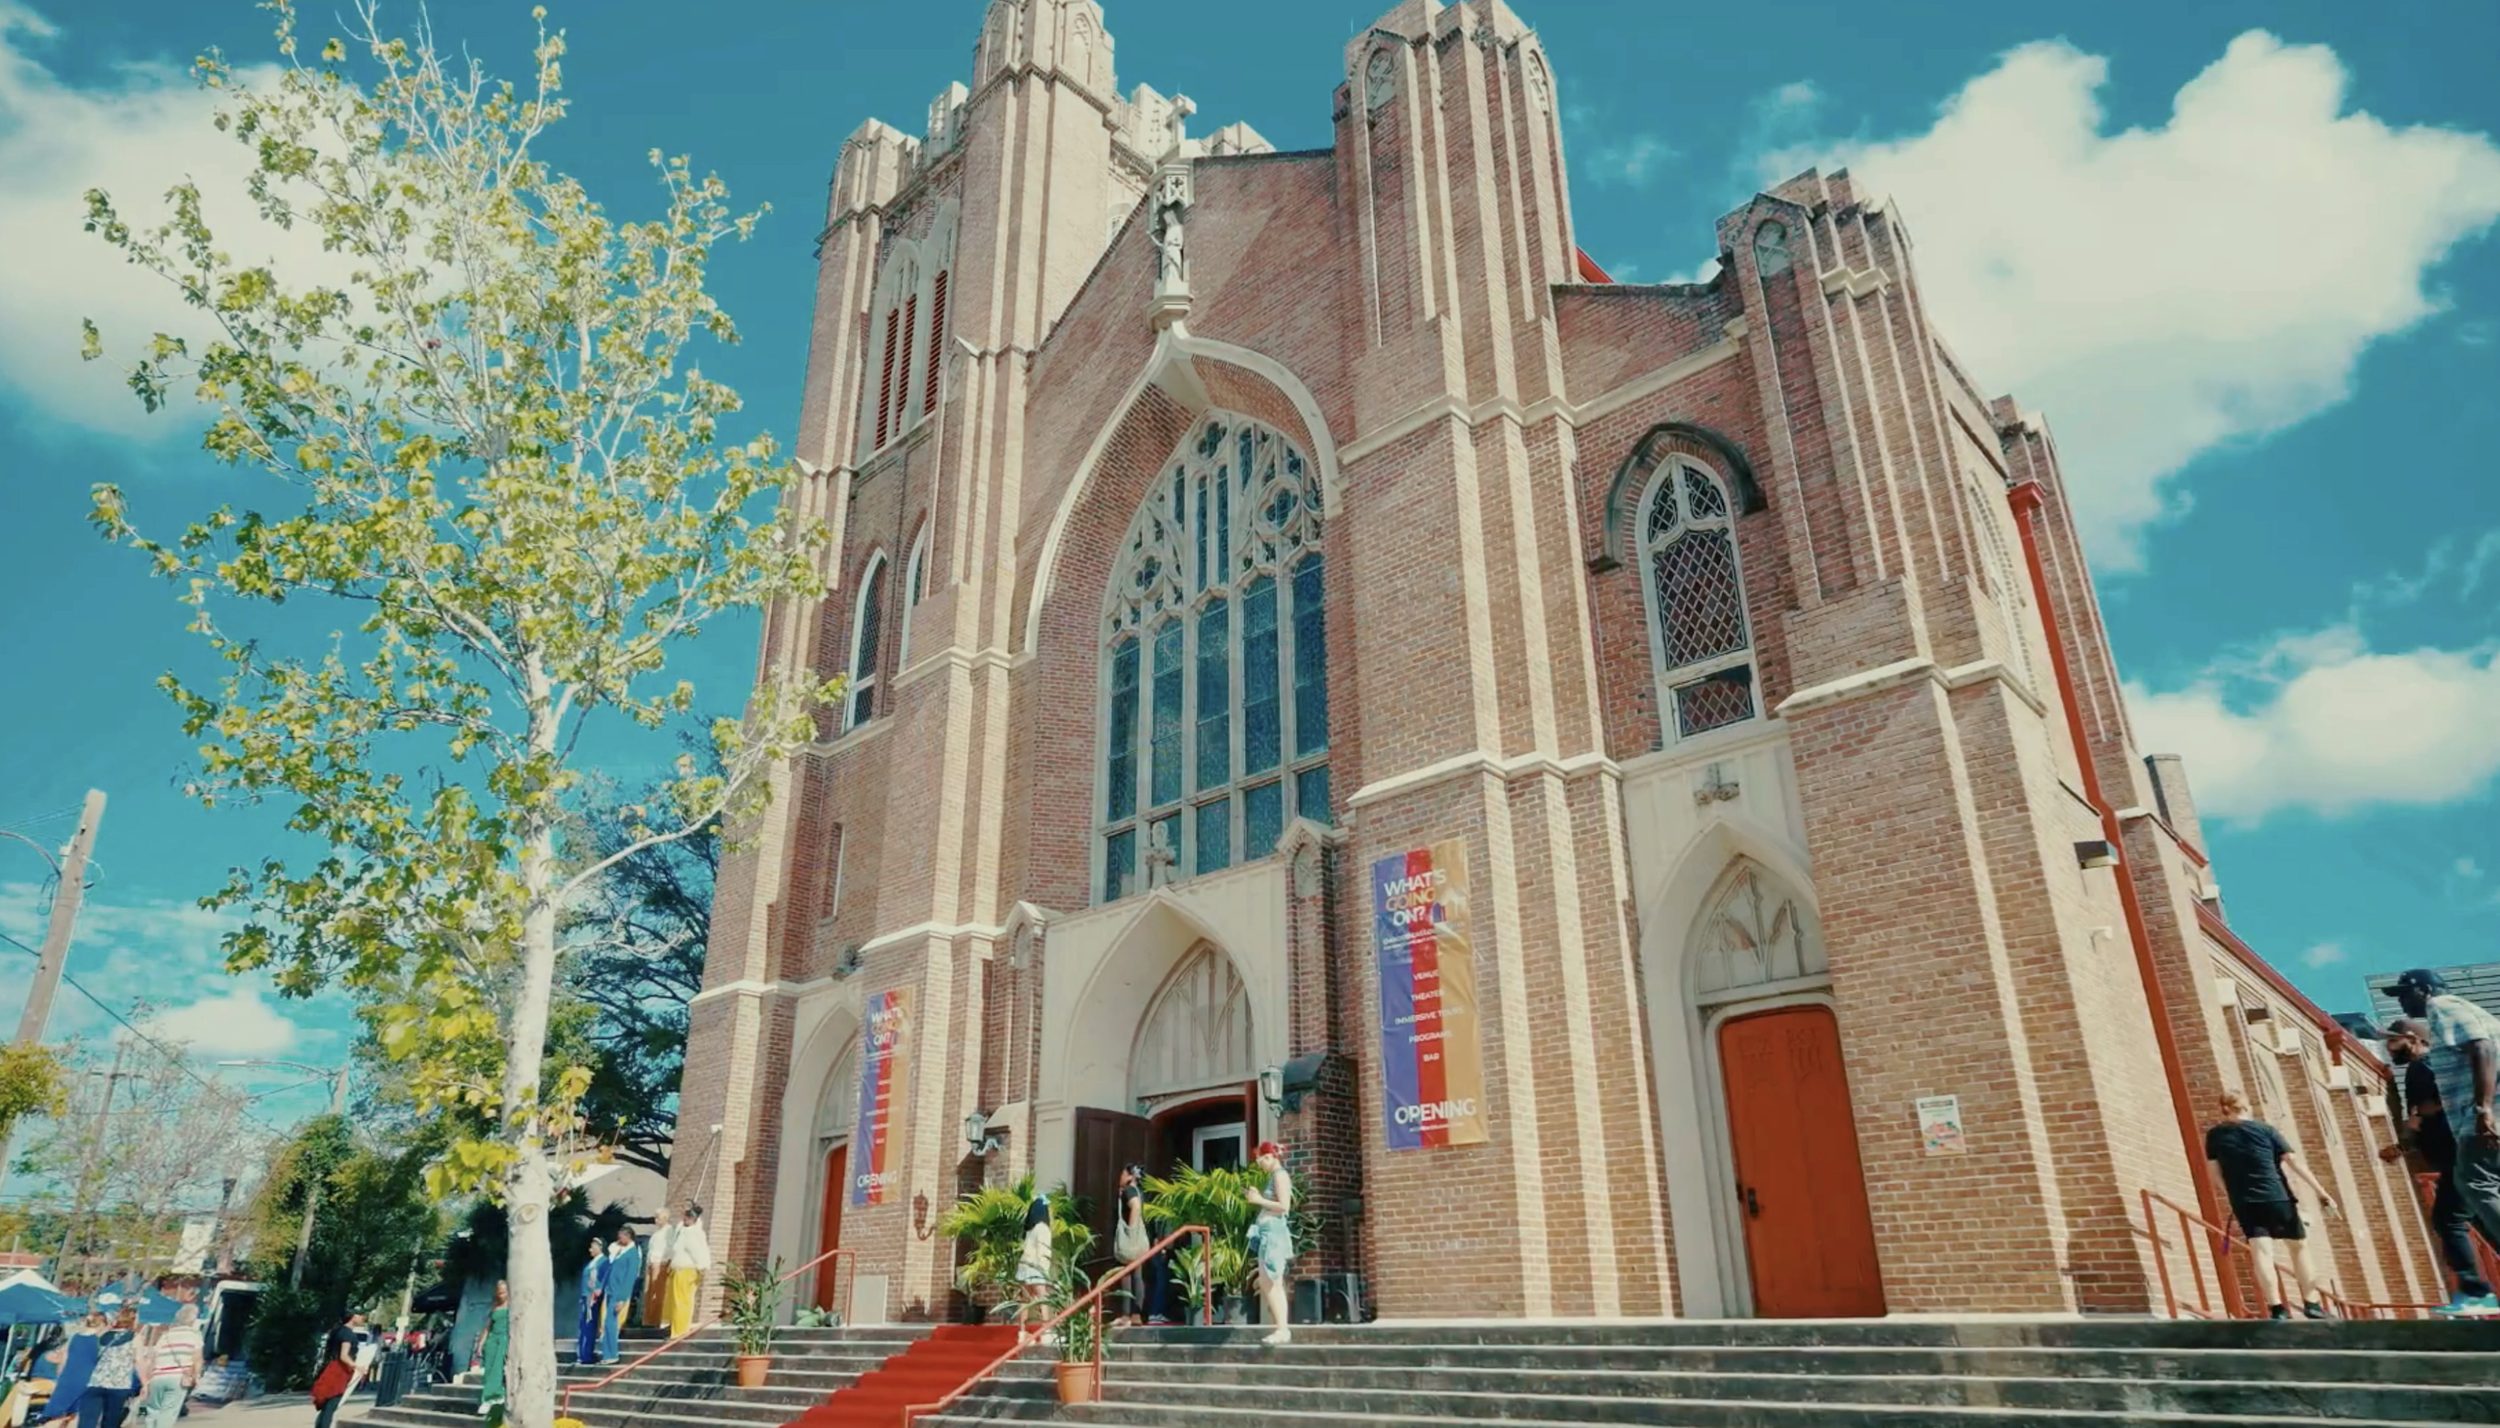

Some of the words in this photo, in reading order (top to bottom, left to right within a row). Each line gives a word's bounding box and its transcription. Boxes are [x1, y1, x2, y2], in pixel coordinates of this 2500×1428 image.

[1383, 868, 1446, 897] WHAT'S
[1385, 887, 1436, 912] GOING
[1393, 905, 1426, 926] ON?
[1411, 990, 1445, 1001] THEATER
[1395, 1011, 1437, 1025] IMMERSIVE
[1423, 1053, 1439, 1062] BAR
[1395, 1098, 1477, 1124] OPENING
[857, 1170, 897, 1187] OPENING
